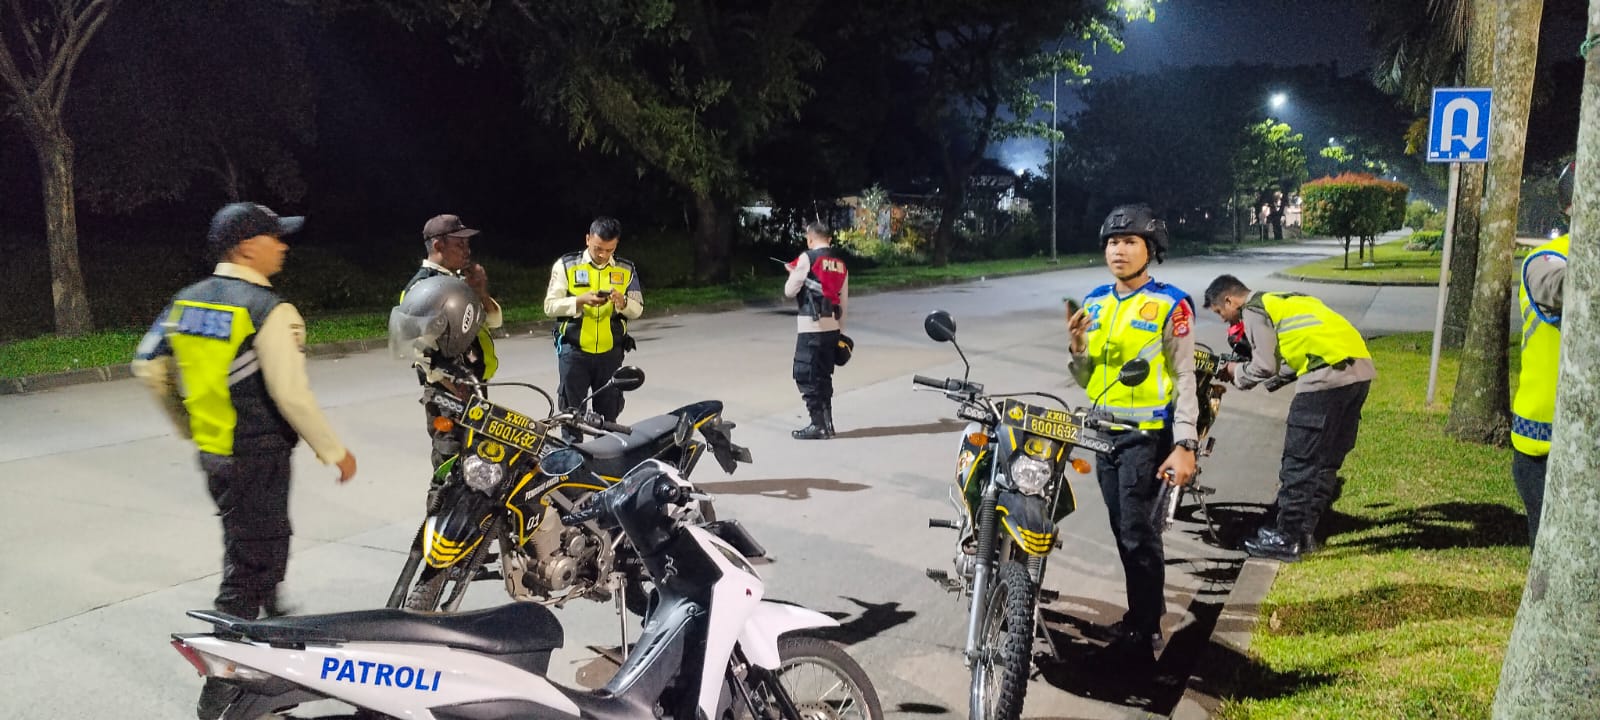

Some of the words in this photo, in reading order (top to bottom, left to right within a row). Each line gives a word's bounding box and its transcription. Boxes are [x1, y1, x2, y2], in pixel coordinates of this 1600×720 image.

[504, 411, 528, 428] XXIII
[526, 513, 540, 530] 01
[320, 657, 442, 692] PATROLI
